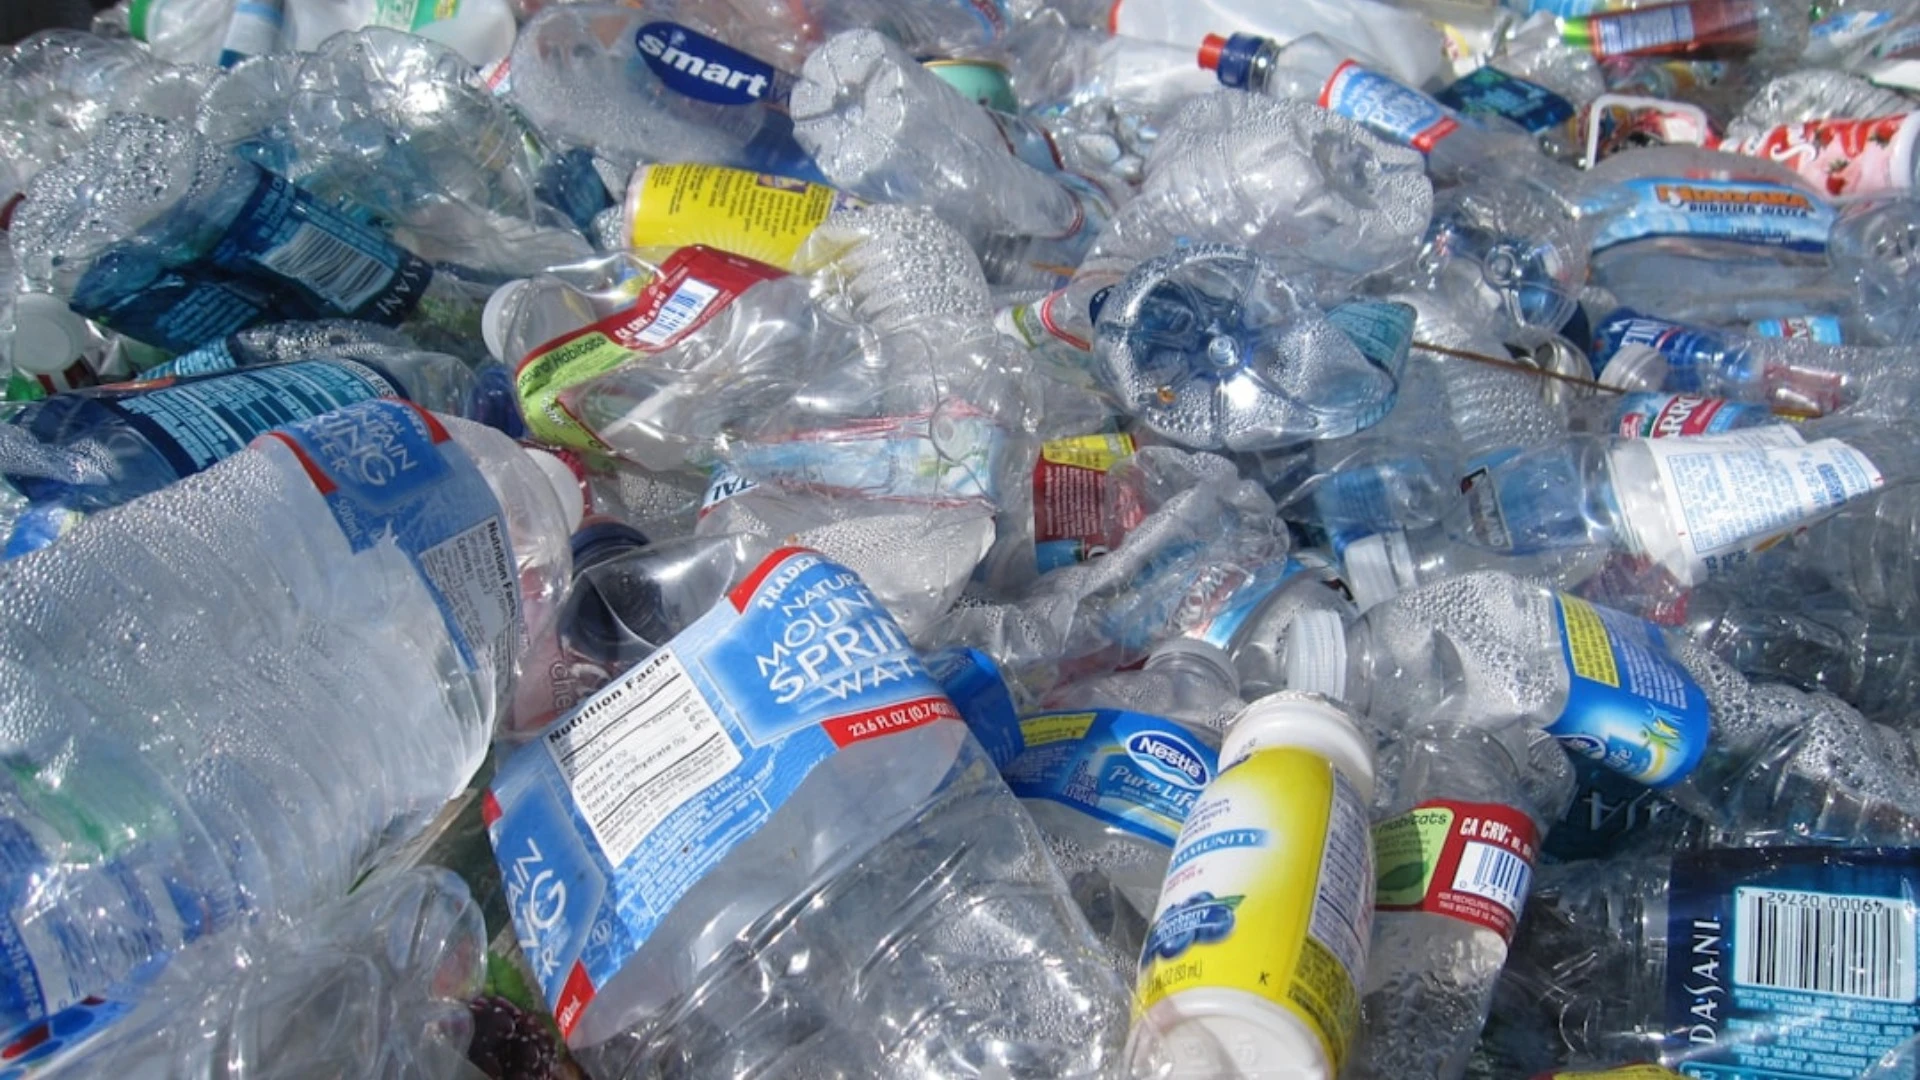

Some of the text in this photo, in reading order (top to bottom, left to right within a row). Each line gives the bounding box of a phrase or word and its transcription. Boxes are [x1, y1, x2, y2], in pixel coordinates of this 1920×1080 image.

[638, 33, 767, 98] smart
[486, 520, 508, 581] Nutrition
[545, 651, 672, 743] Nutrition Facts
[847, 718, 880, 737] 23.6
[878, 715, 896, 731] FL
[893, 711, 911, 727] OZ
[1109, 765, 1161, 794] Pure
[1459, 817, 1478, 837] CA
[1766, 890, 1820, 910] 02762
[1828, 896, 1884, 914] 49000
[1683, 919, 1726, 1045] DASANI
